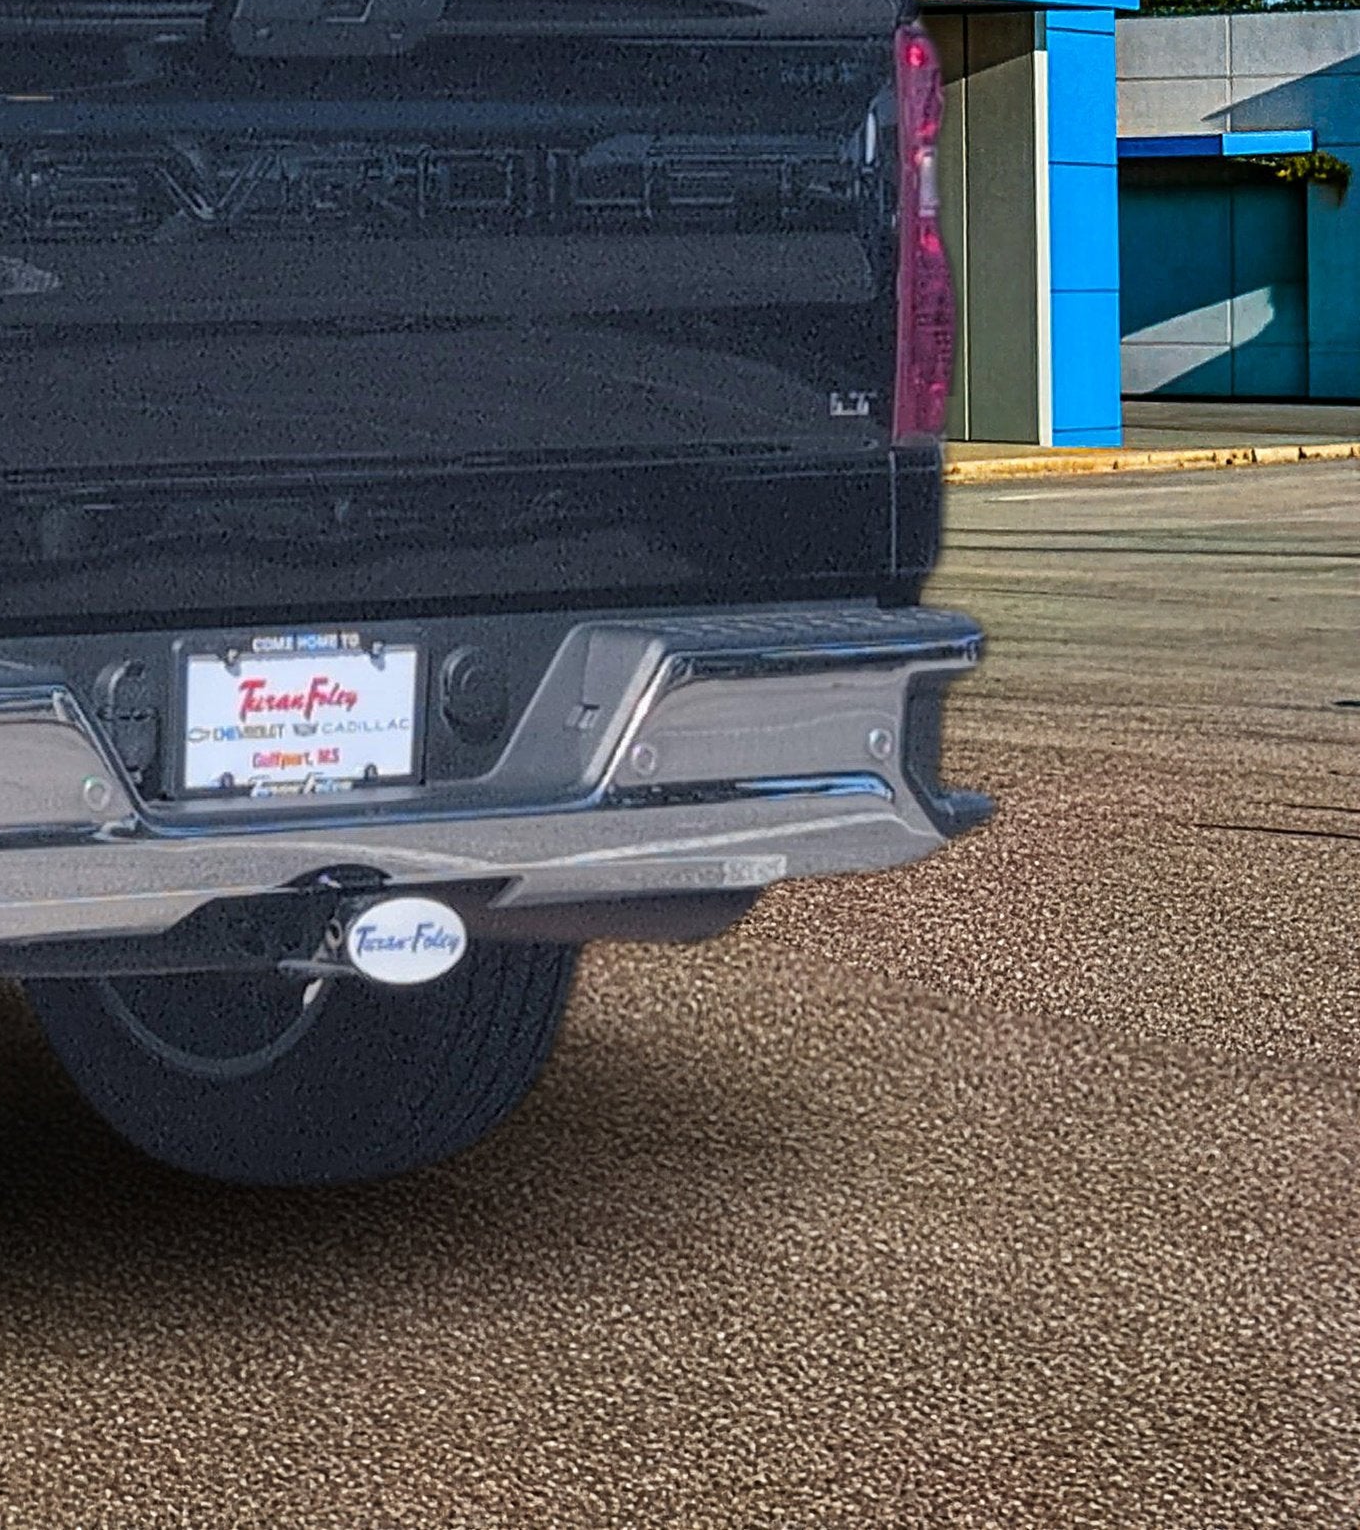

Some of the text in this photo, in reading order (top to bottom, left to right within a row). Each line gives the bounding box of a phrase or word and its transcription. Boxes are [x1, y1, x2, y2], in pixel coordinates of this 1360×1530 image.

[252, 632, 360, 652] COME HOME TO
[239, 676, 357, 722] Turan Foley
[213, 718, 410, 741] CHEVROLET CADILLAC
[317, 748, 340, 764] MS
[411, 921, 461, 955] Foley
